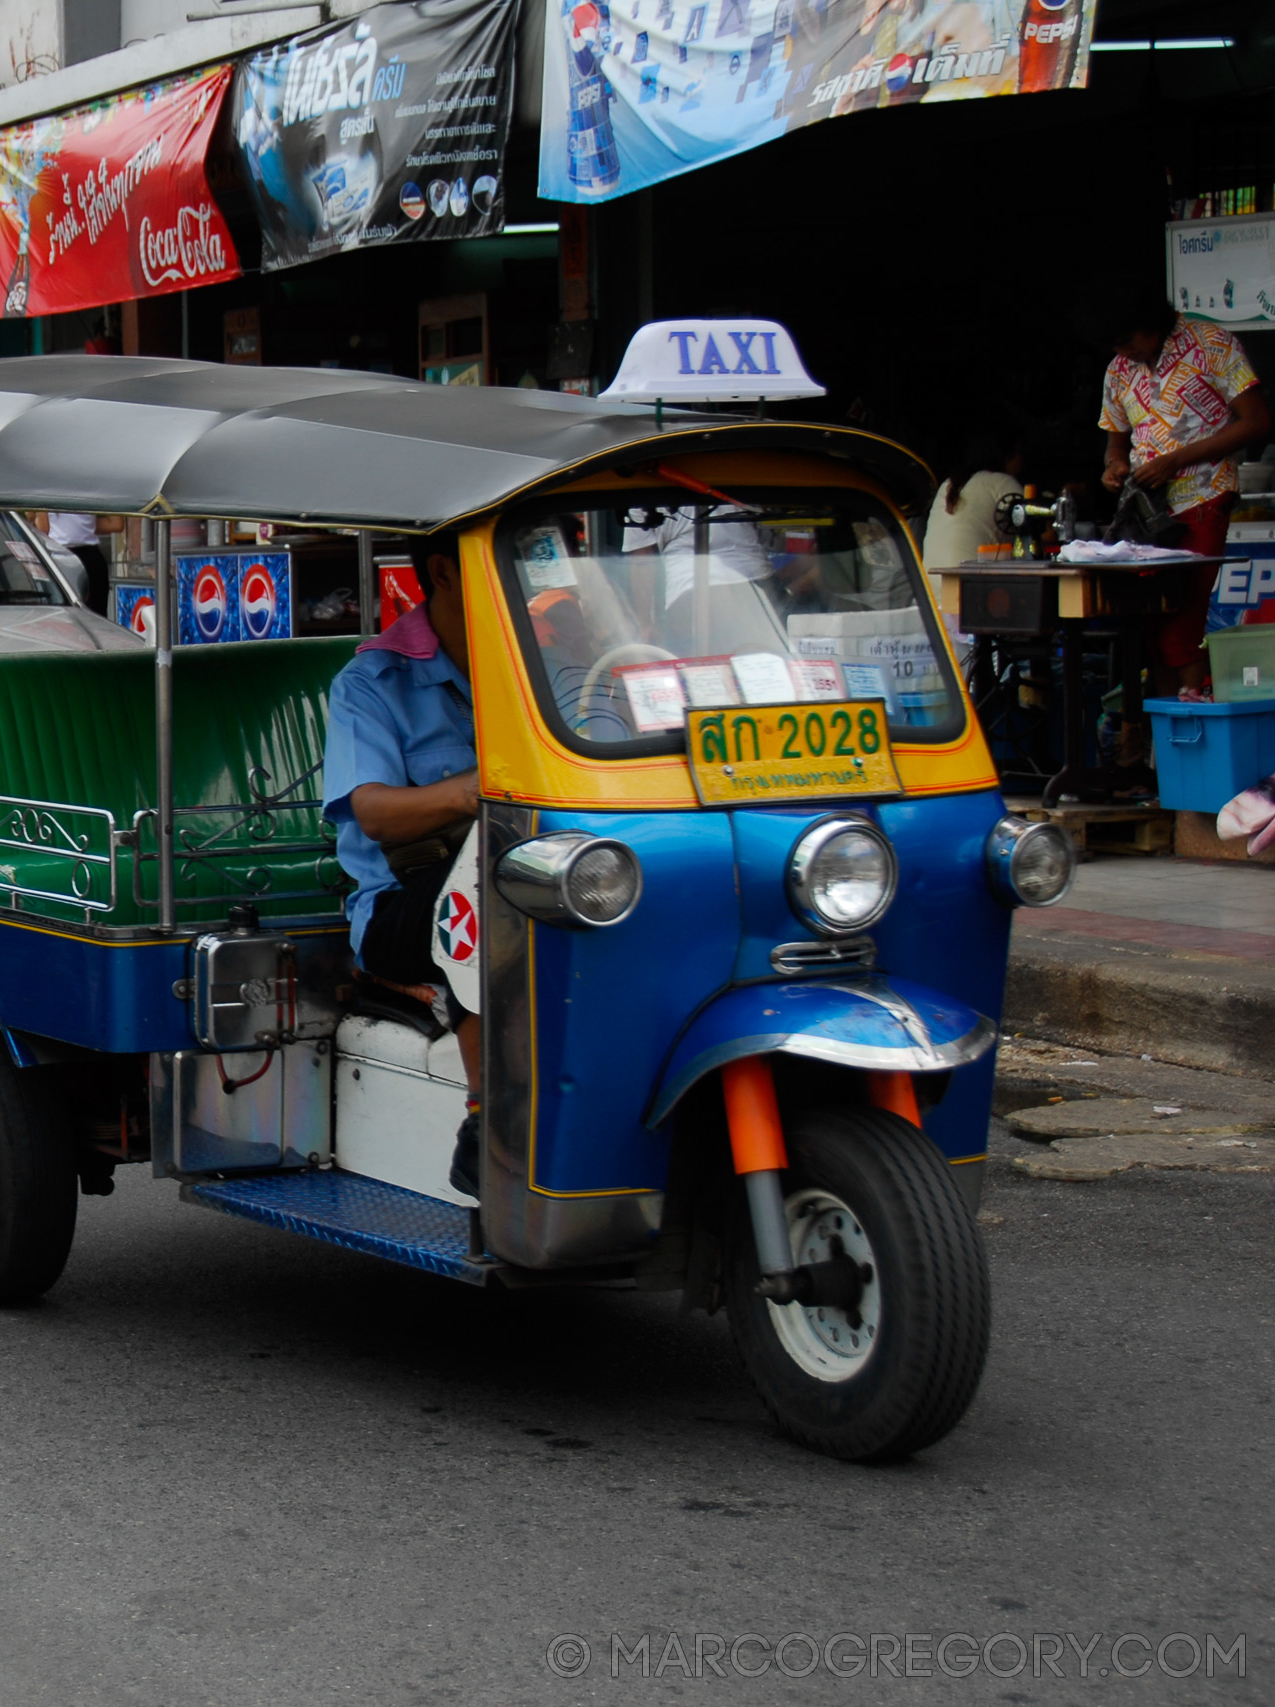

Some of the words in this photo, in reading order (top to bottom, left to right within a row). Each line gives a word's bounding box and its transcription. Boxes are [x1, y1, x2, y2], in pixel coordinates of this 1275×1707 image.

[1023, 15, 1079, 44] PEPSI
[912, 33, 1012, 84] เต็มที่
[1177, 231, 1214, 254] ไอศกรีม
[667, 331, 782, 375] TAXI
[1212, 558, 1275, 604] EP
[893, 660, 914, 677] 10
[778, 708, 880, 759] 2028
